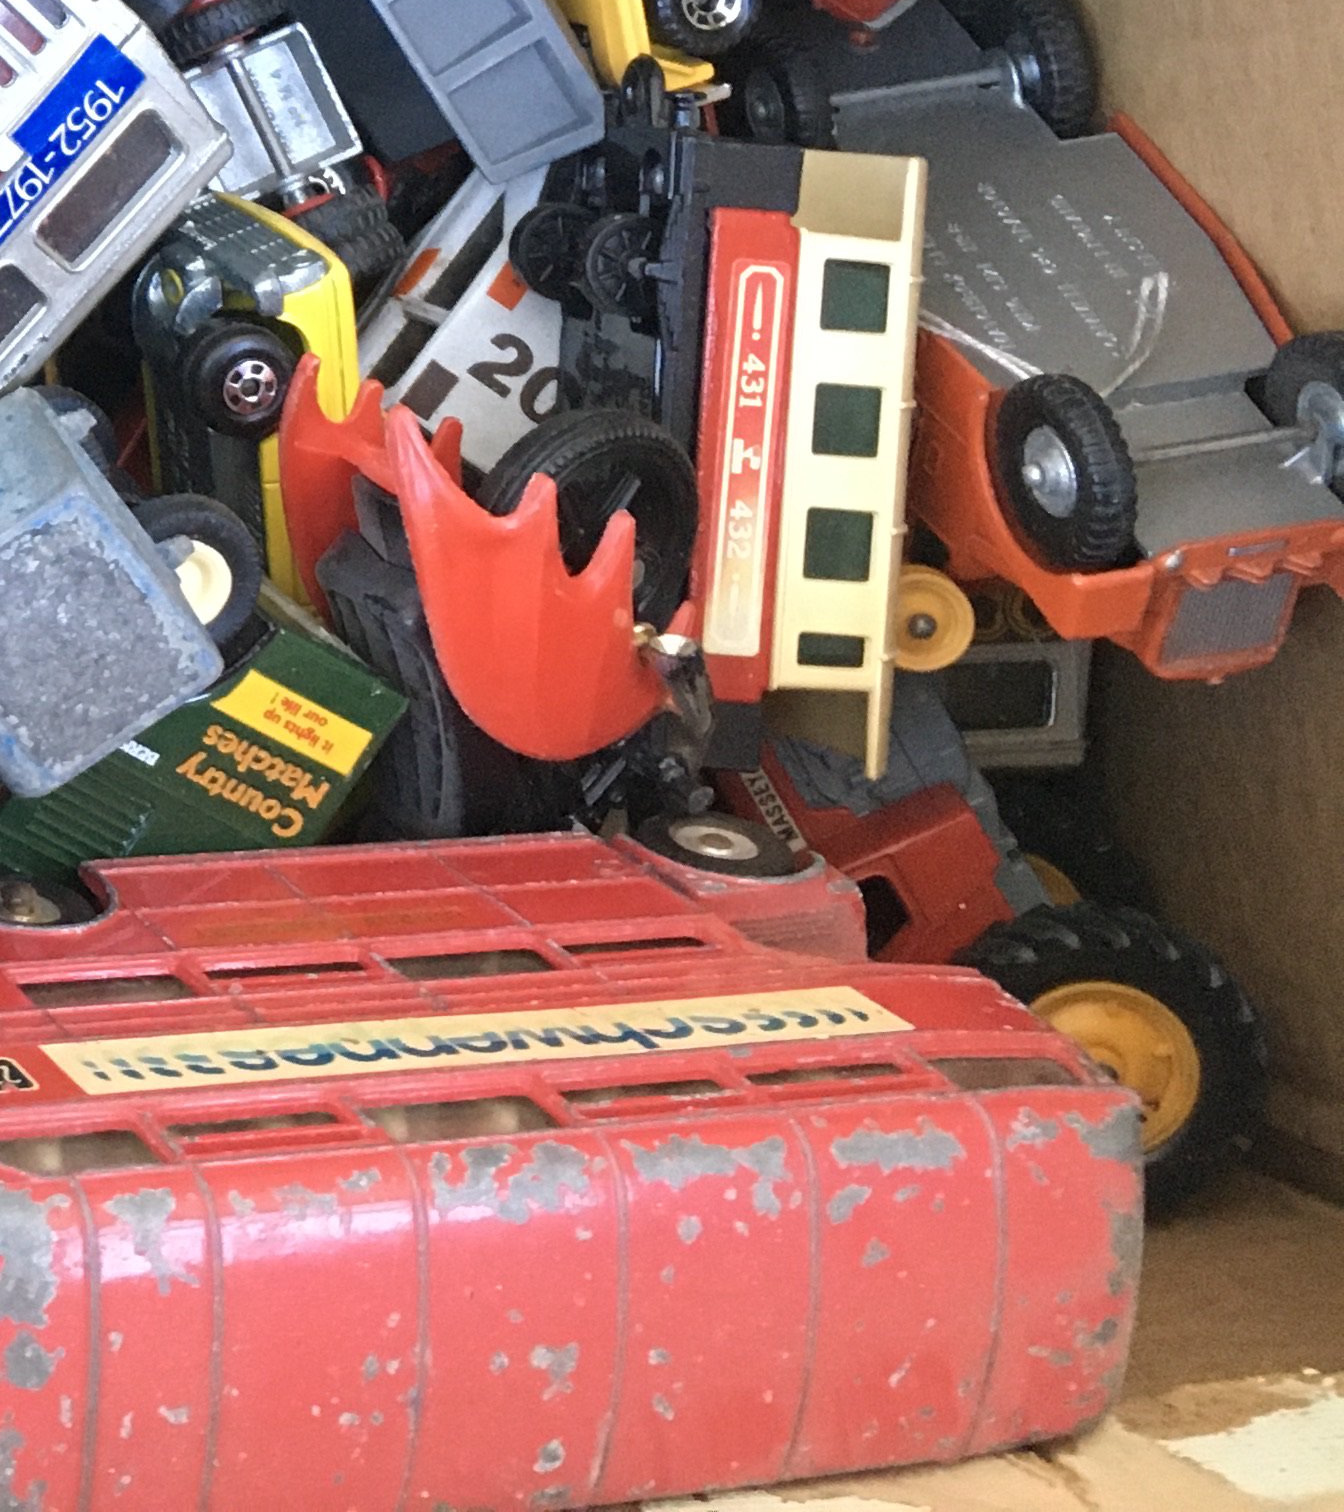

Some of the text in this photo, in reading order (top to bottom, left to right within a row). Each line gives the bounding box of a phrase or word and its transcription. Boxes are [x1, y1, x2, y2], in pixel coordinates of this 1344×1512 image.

[466, 336, 570, 423] 20
[737, 352, 766, 408] 431
[725, 499, 753, 560] 432
[260, 705, 284, 727] up
[277, 695, 303, 718] life
[281, 715, 322, 748] lights
[174, 751, 301, 838] Country
[199, 721, 331, 809] Matches
[745, 771, 798, 845] MASSEY
